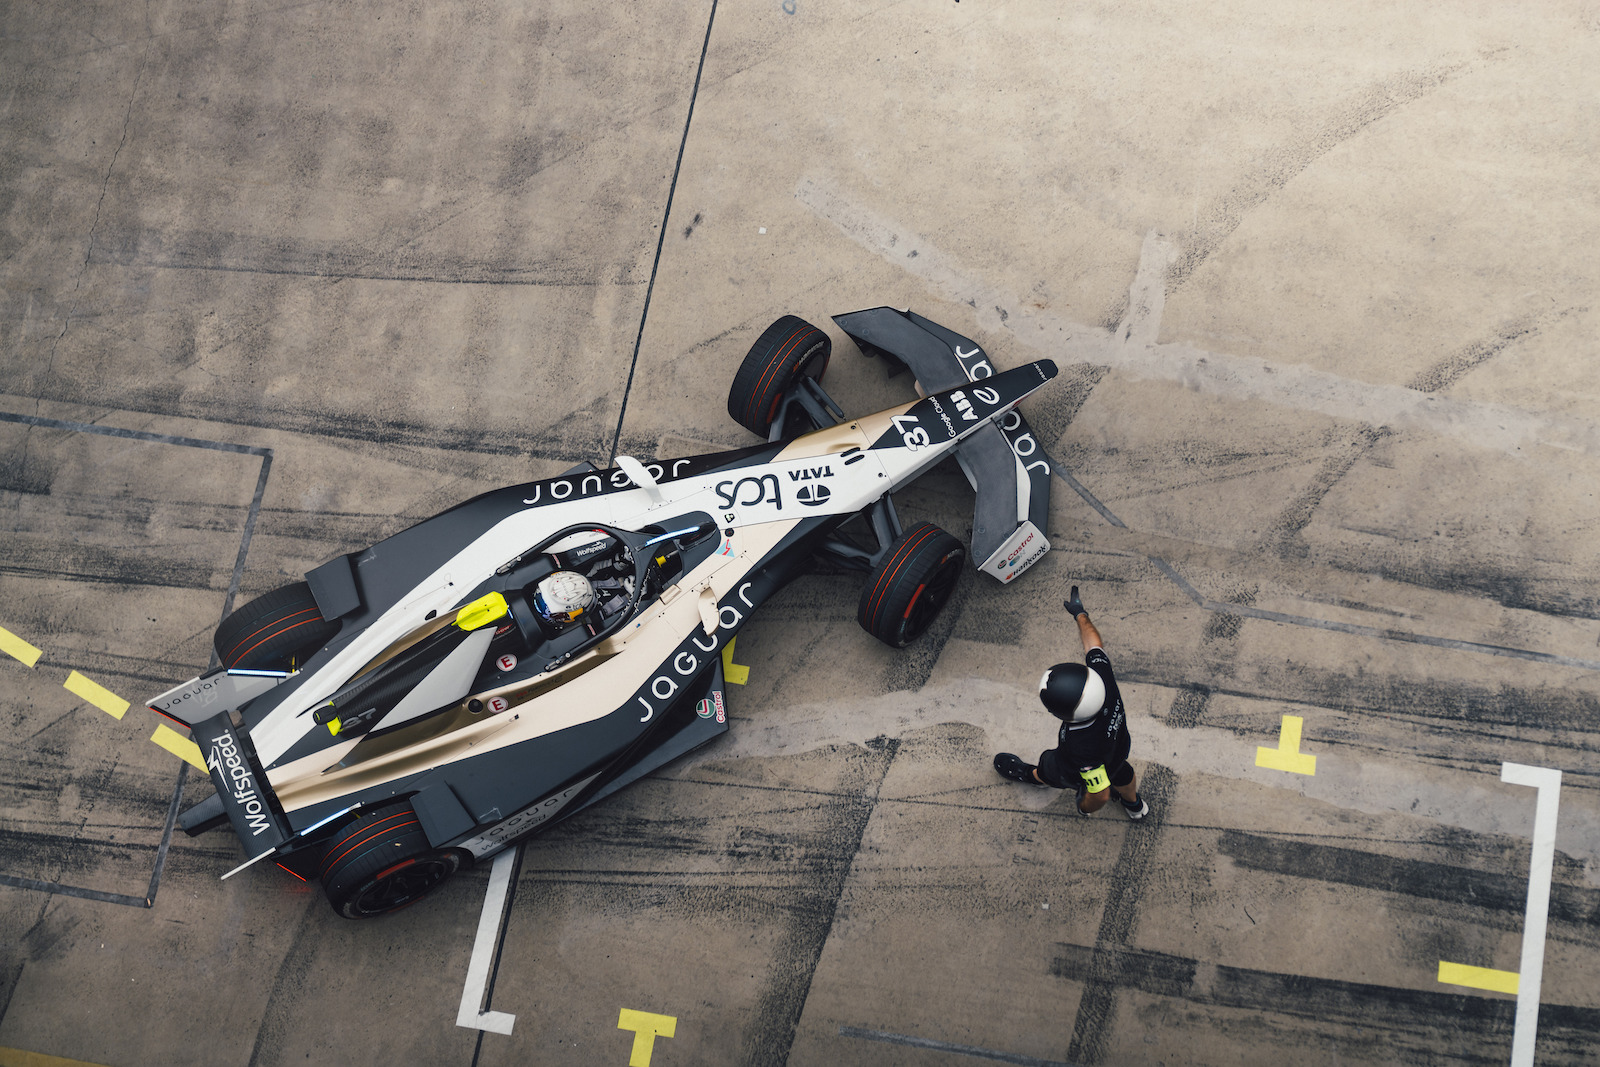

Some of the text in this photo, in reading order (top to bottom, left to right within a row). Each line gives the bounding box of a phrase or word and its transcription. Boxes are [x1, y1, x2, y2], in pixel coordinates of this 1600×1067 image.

[928, 396, 956, 438] Google Cloud
[950, 390, 978, 421] ABB
[889, 415, 930, 451] 37
[788, 465, 834, 481] TATA
[715, 474, 782, 511] tcs
[576, 542, 607, 558] Wolfspeed
[1007, 532, 1034, 562] Castrol
[1013, 543, 1047, 575] Hankook
[501, 656, 513, 669] E
[492, 699, 504, 711] E
[716, 691, 724, 723] Castrol
